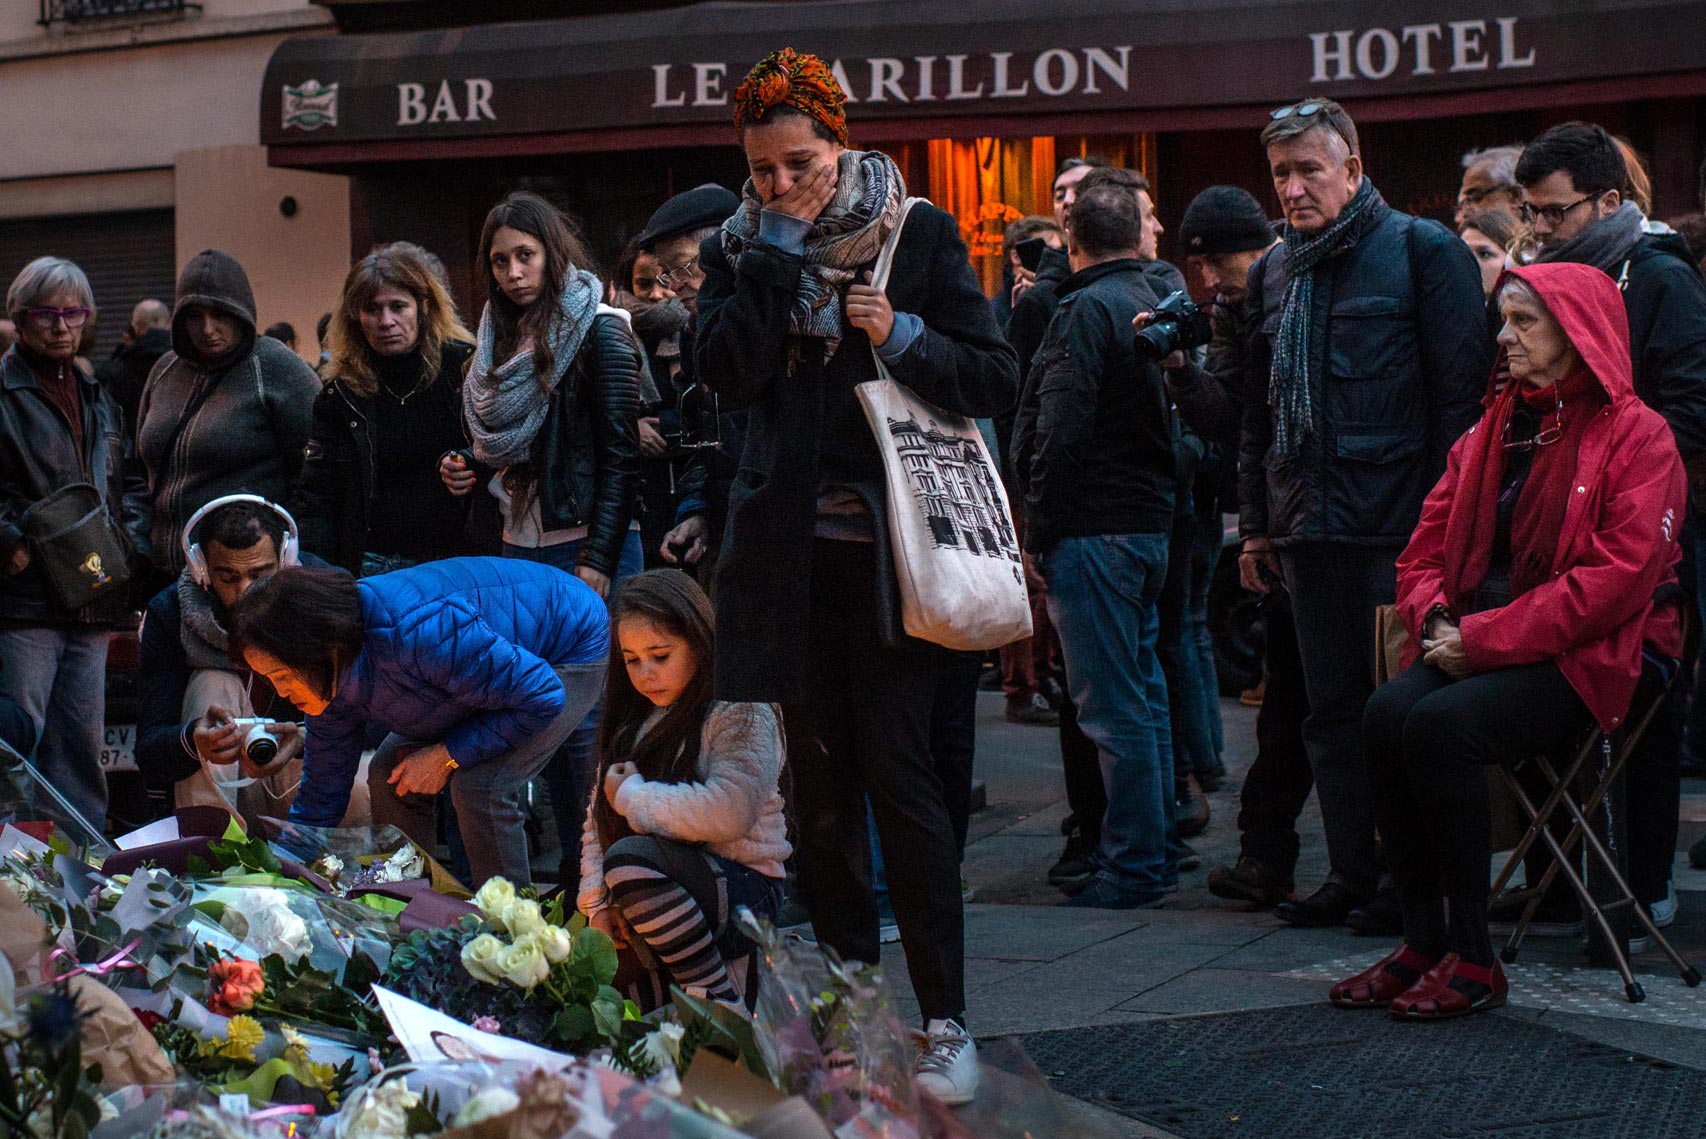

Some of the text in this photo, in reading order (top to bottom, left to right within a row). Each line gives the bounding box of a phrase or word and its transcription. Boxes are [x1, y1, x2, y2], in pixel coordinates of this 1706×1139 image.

[650, 46, 1132, 108] LE ARILLON
[1308, 16, 1536, 83] HOTEL
[397, 78, 497, 126] BAR
